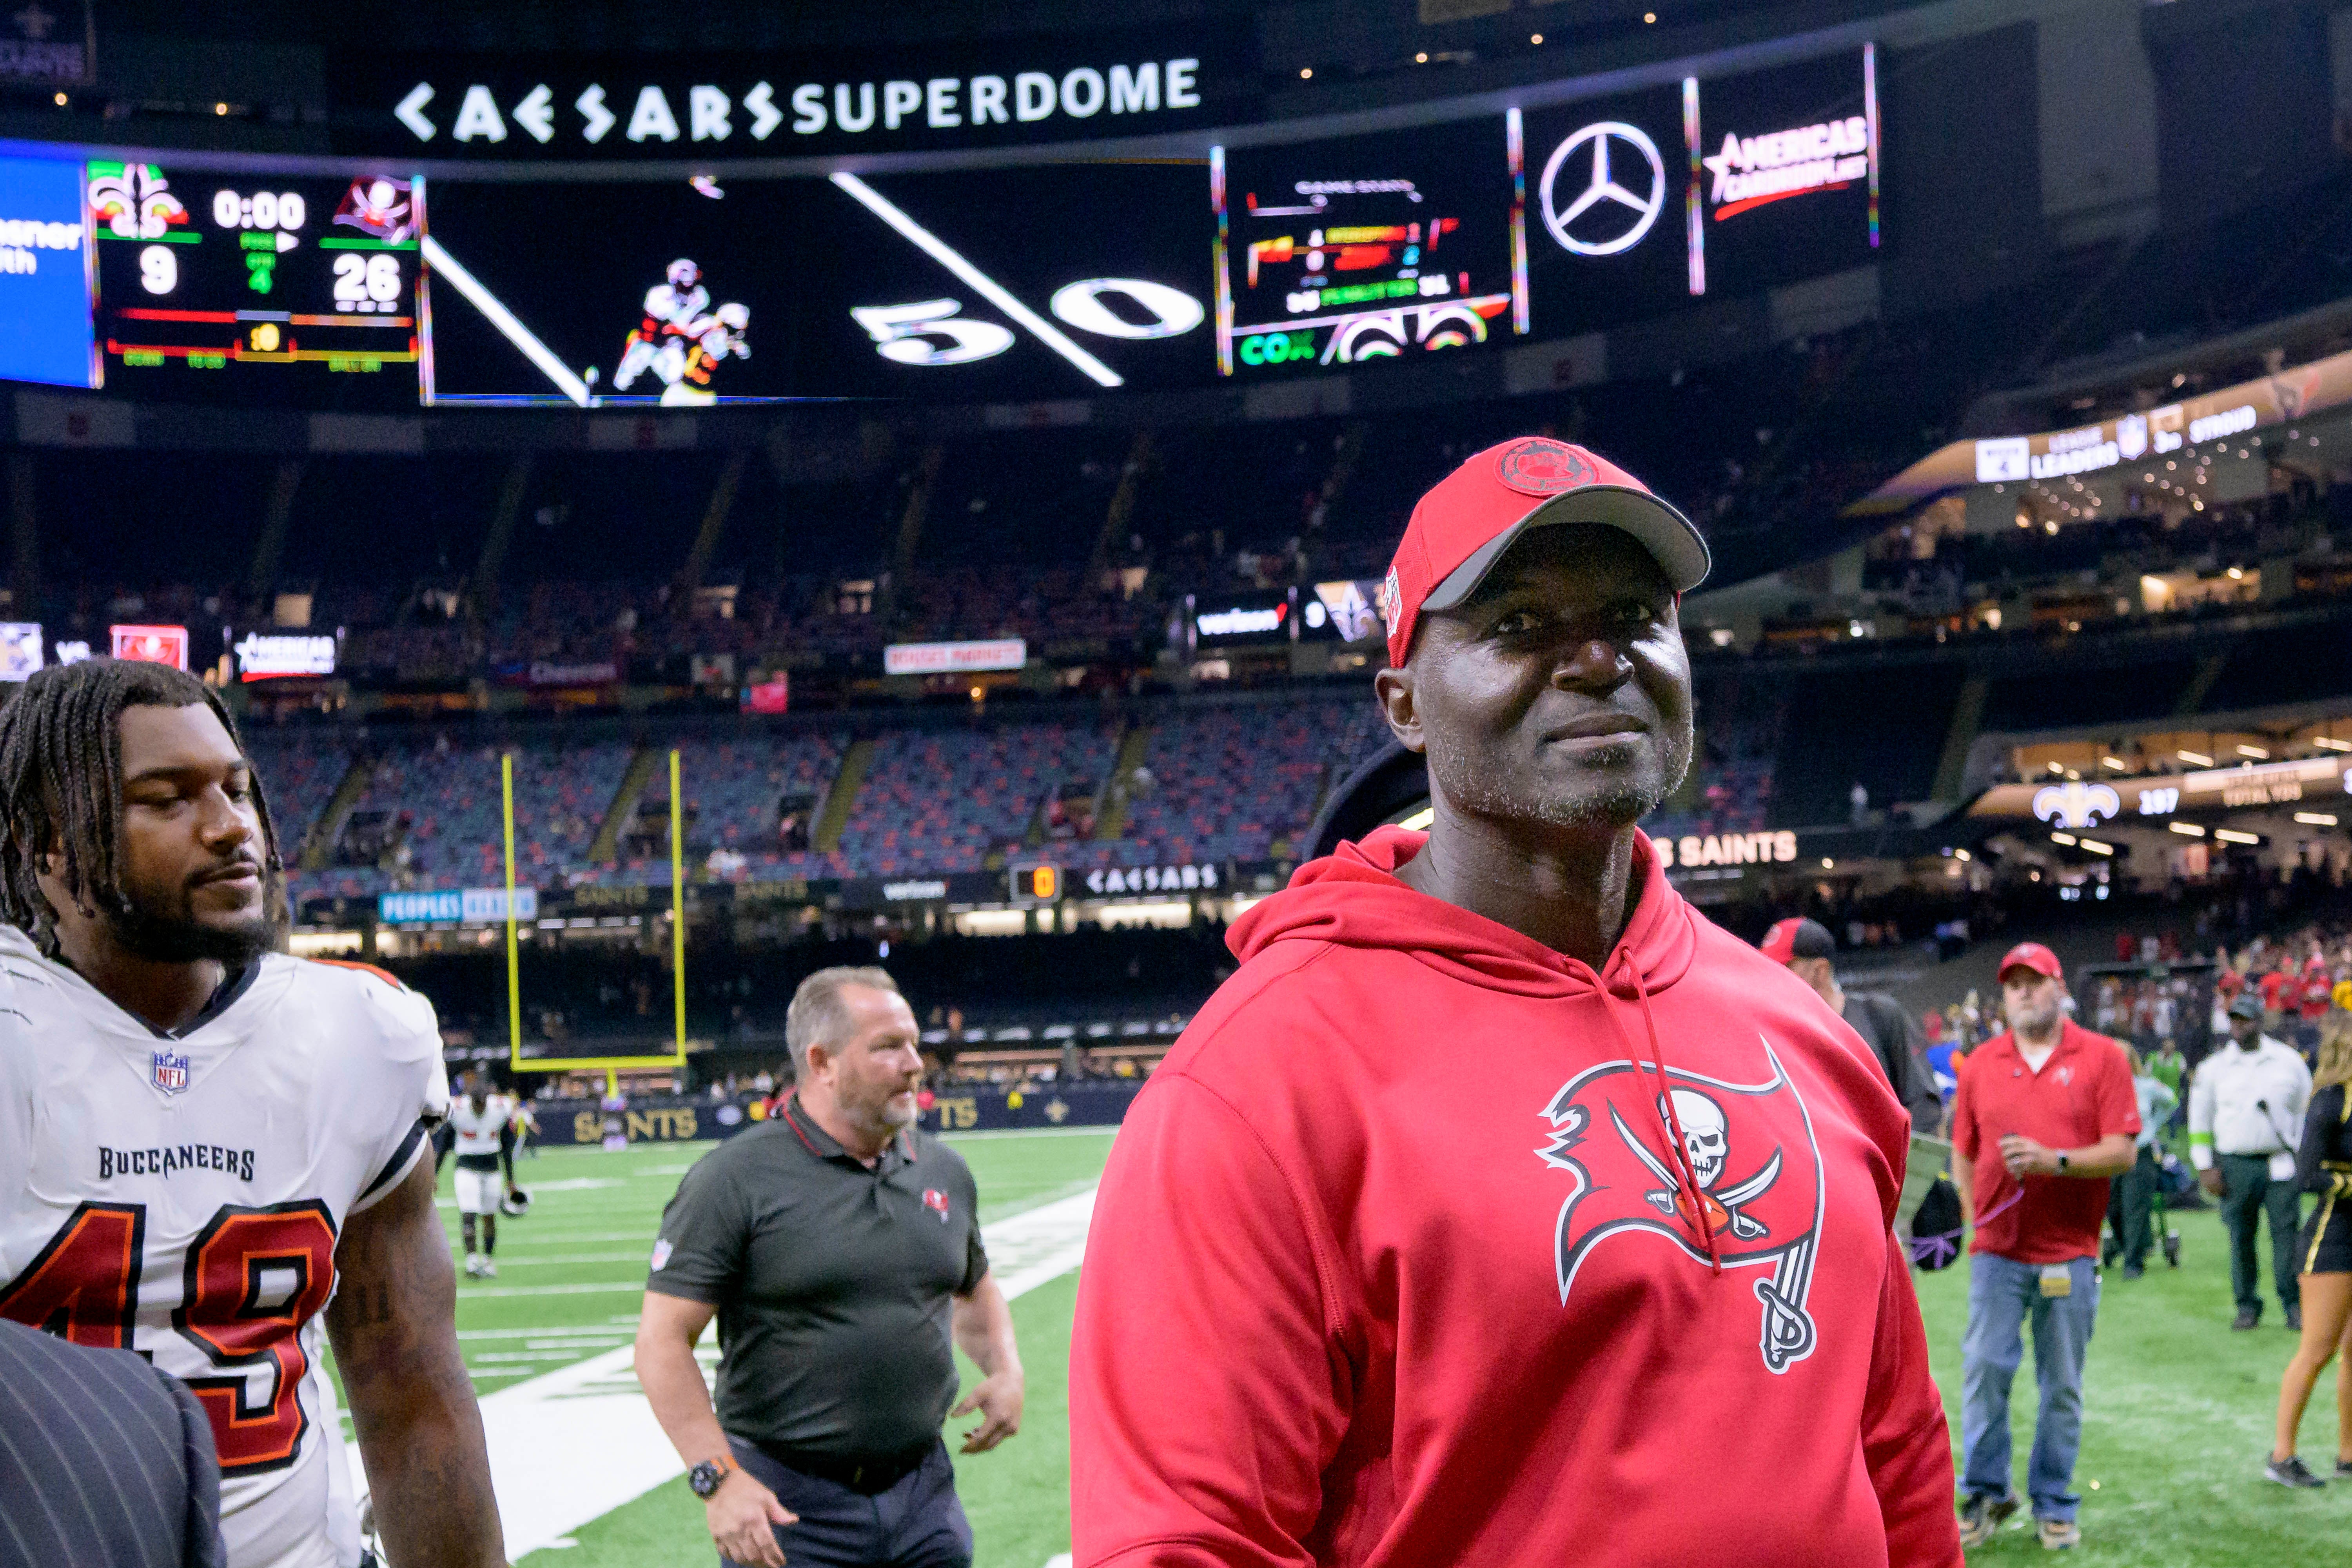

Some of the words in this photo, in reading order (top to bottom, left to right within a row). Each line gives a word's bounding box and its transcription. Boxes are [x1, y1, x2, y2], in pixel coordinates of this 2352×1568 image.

[394, 81, 783, 144] CAESARS
[791, 58, 1200, 134] SUPERDOME
[1721, 116, 1867, 173] AMERICAS
[214, 189, 306, 230] 0:00
[140, 245, 178, 294] 9
[332, 253, 401, 303] 26
[1240, 329, 1316, 365] COX
[1679, 830, 1797, 867] SAINTS
[1087, 863, 1218, 894] CAESARS
[158, 1068, 185, 1087] NFL
[98, 1143, 255, 1182] BUCCANEERS
